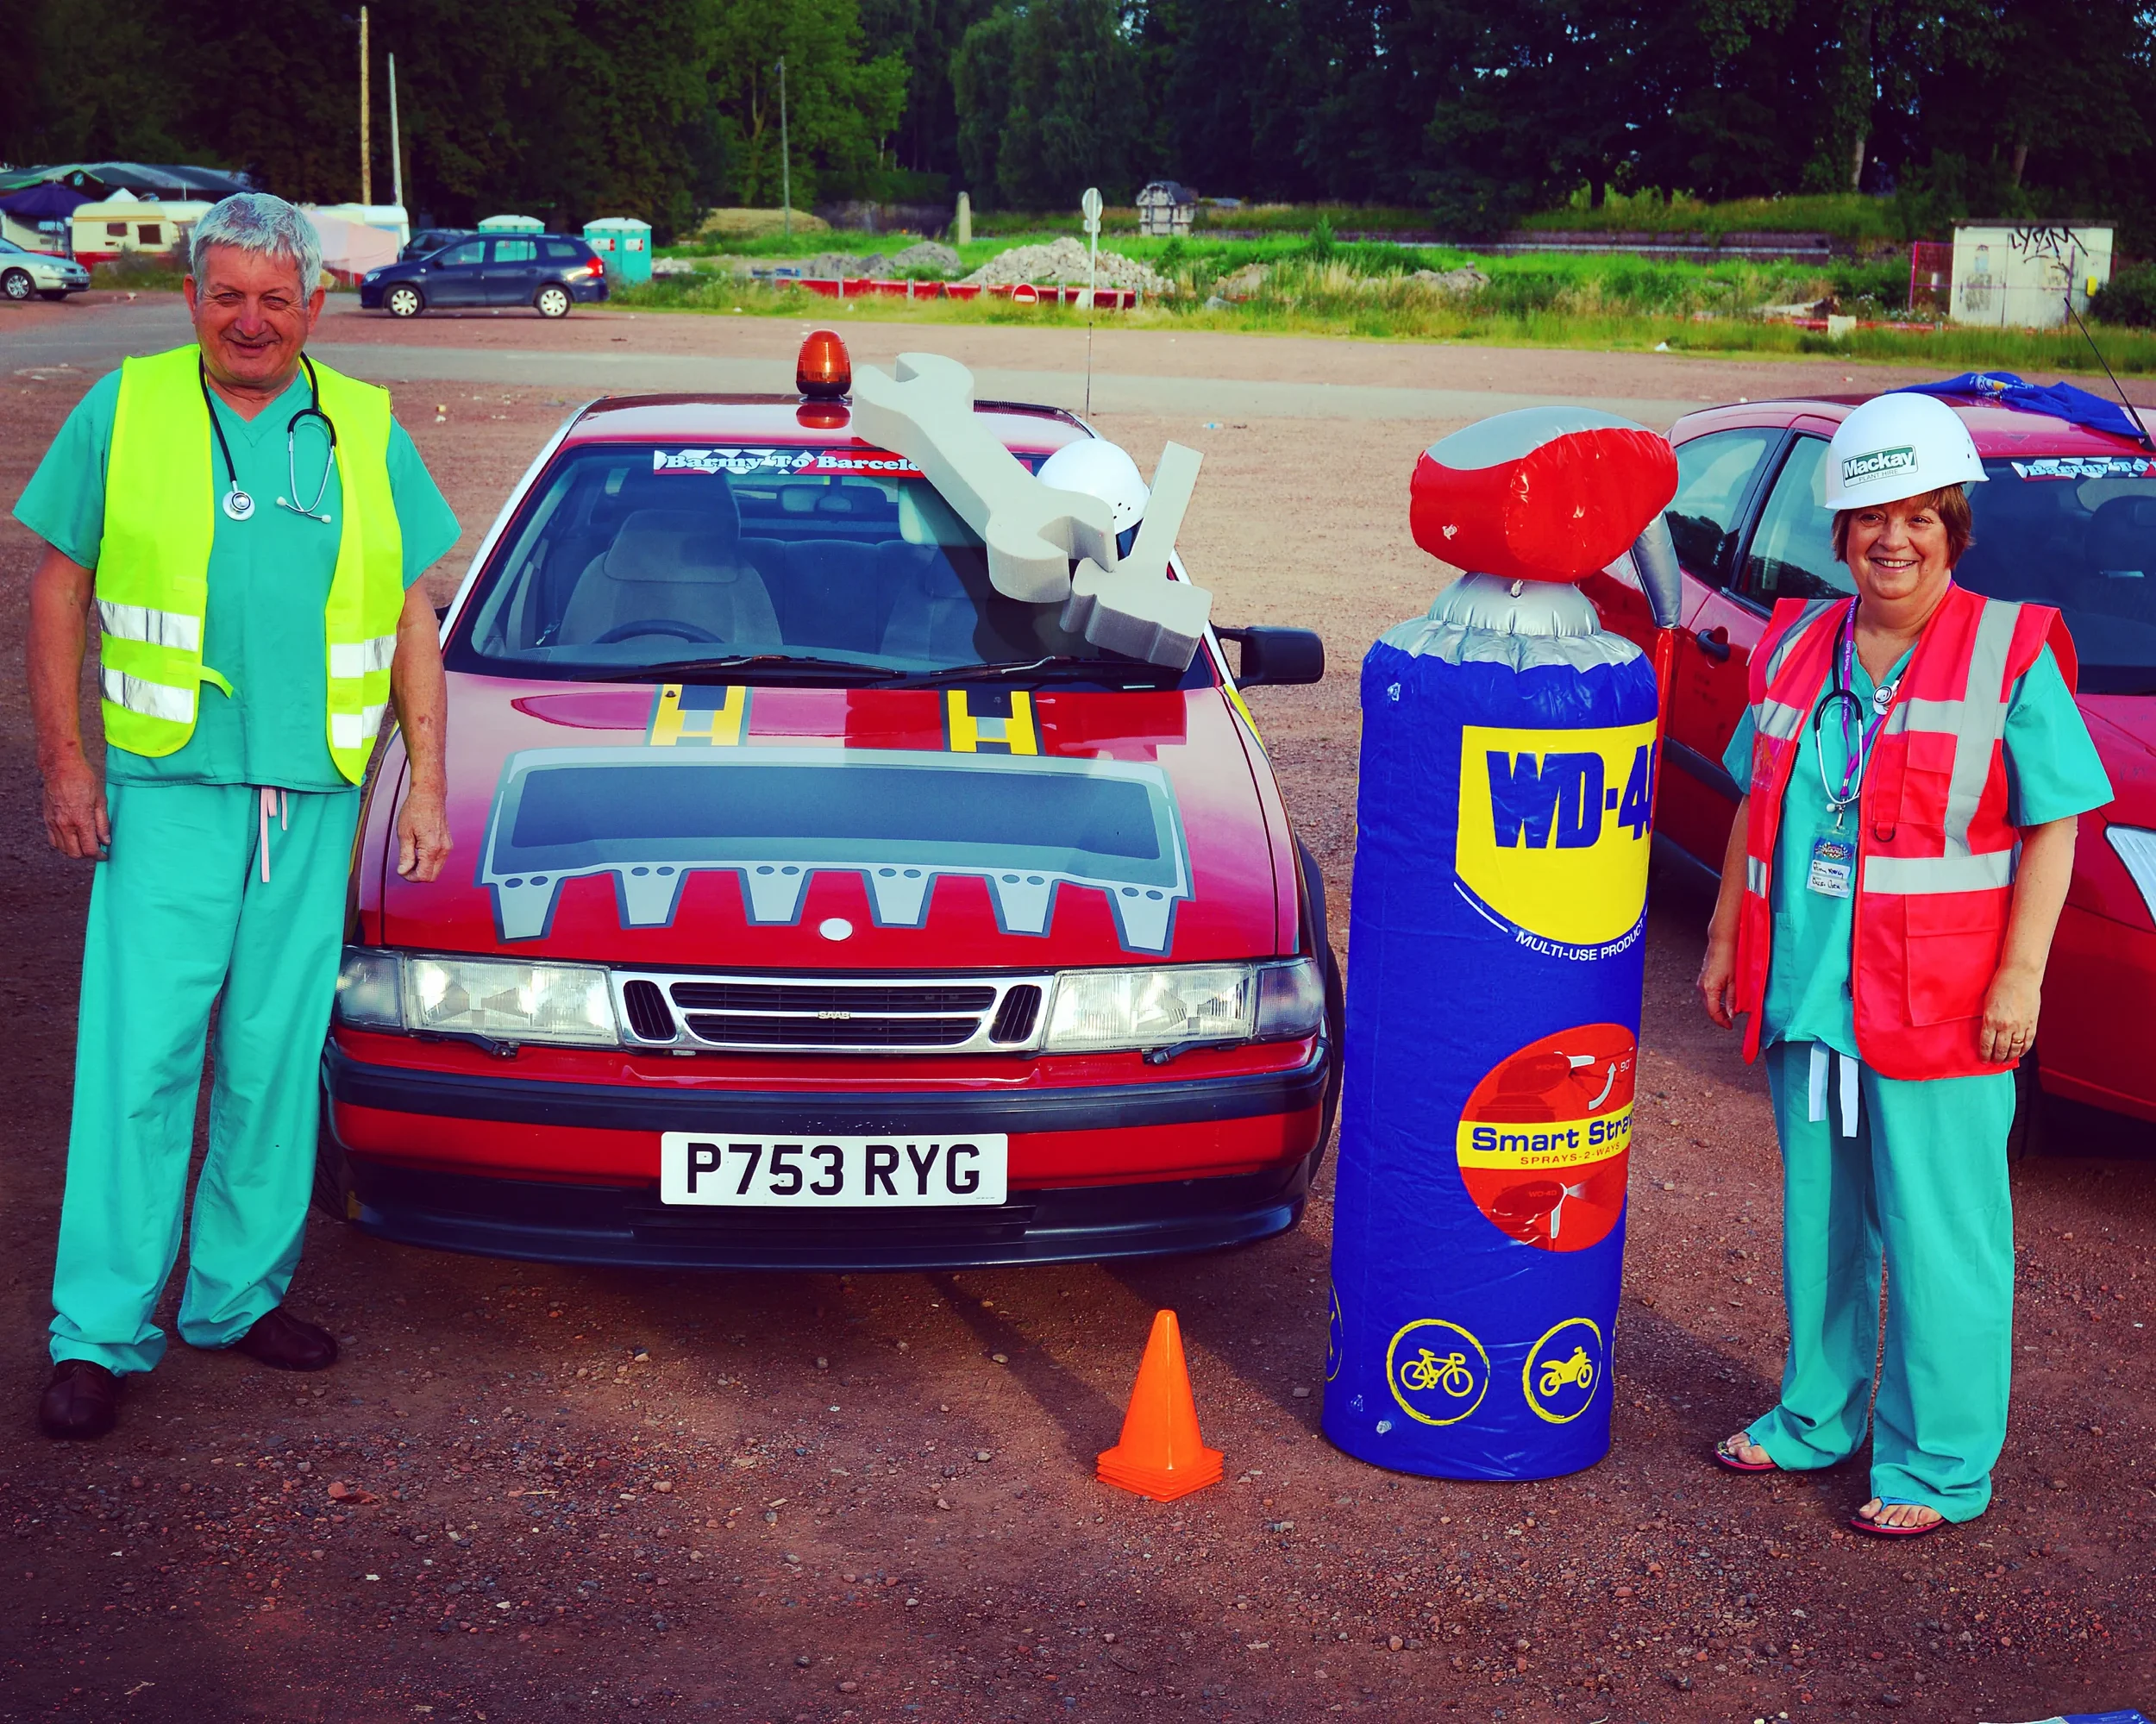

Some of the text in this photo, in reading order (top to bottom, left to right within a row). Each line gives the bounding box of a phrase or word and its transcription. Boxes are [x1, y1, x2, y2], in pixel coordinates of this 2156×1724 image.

[664, 454, 763, 471] Barmy
[770, 455, 811, 470] To
[1844, 452, 1914, 479] Mackay
[2025, 463, 2109, 476] Barmy
[2114, 461, 2148, 472] To
[1858, 468, 1899, 482] PLANT HIRE
[1515, 918, 1644, 962] MULTI-USE PRODUCT
[818, 1011, 850, 1019] SAAB
[1472, 1126, 1579, 1152] Smart
[1520, 1142, 1620, 1165] SPRAYS-2-WAYS
[687, 1142, 980, 1196] P753 RYG
